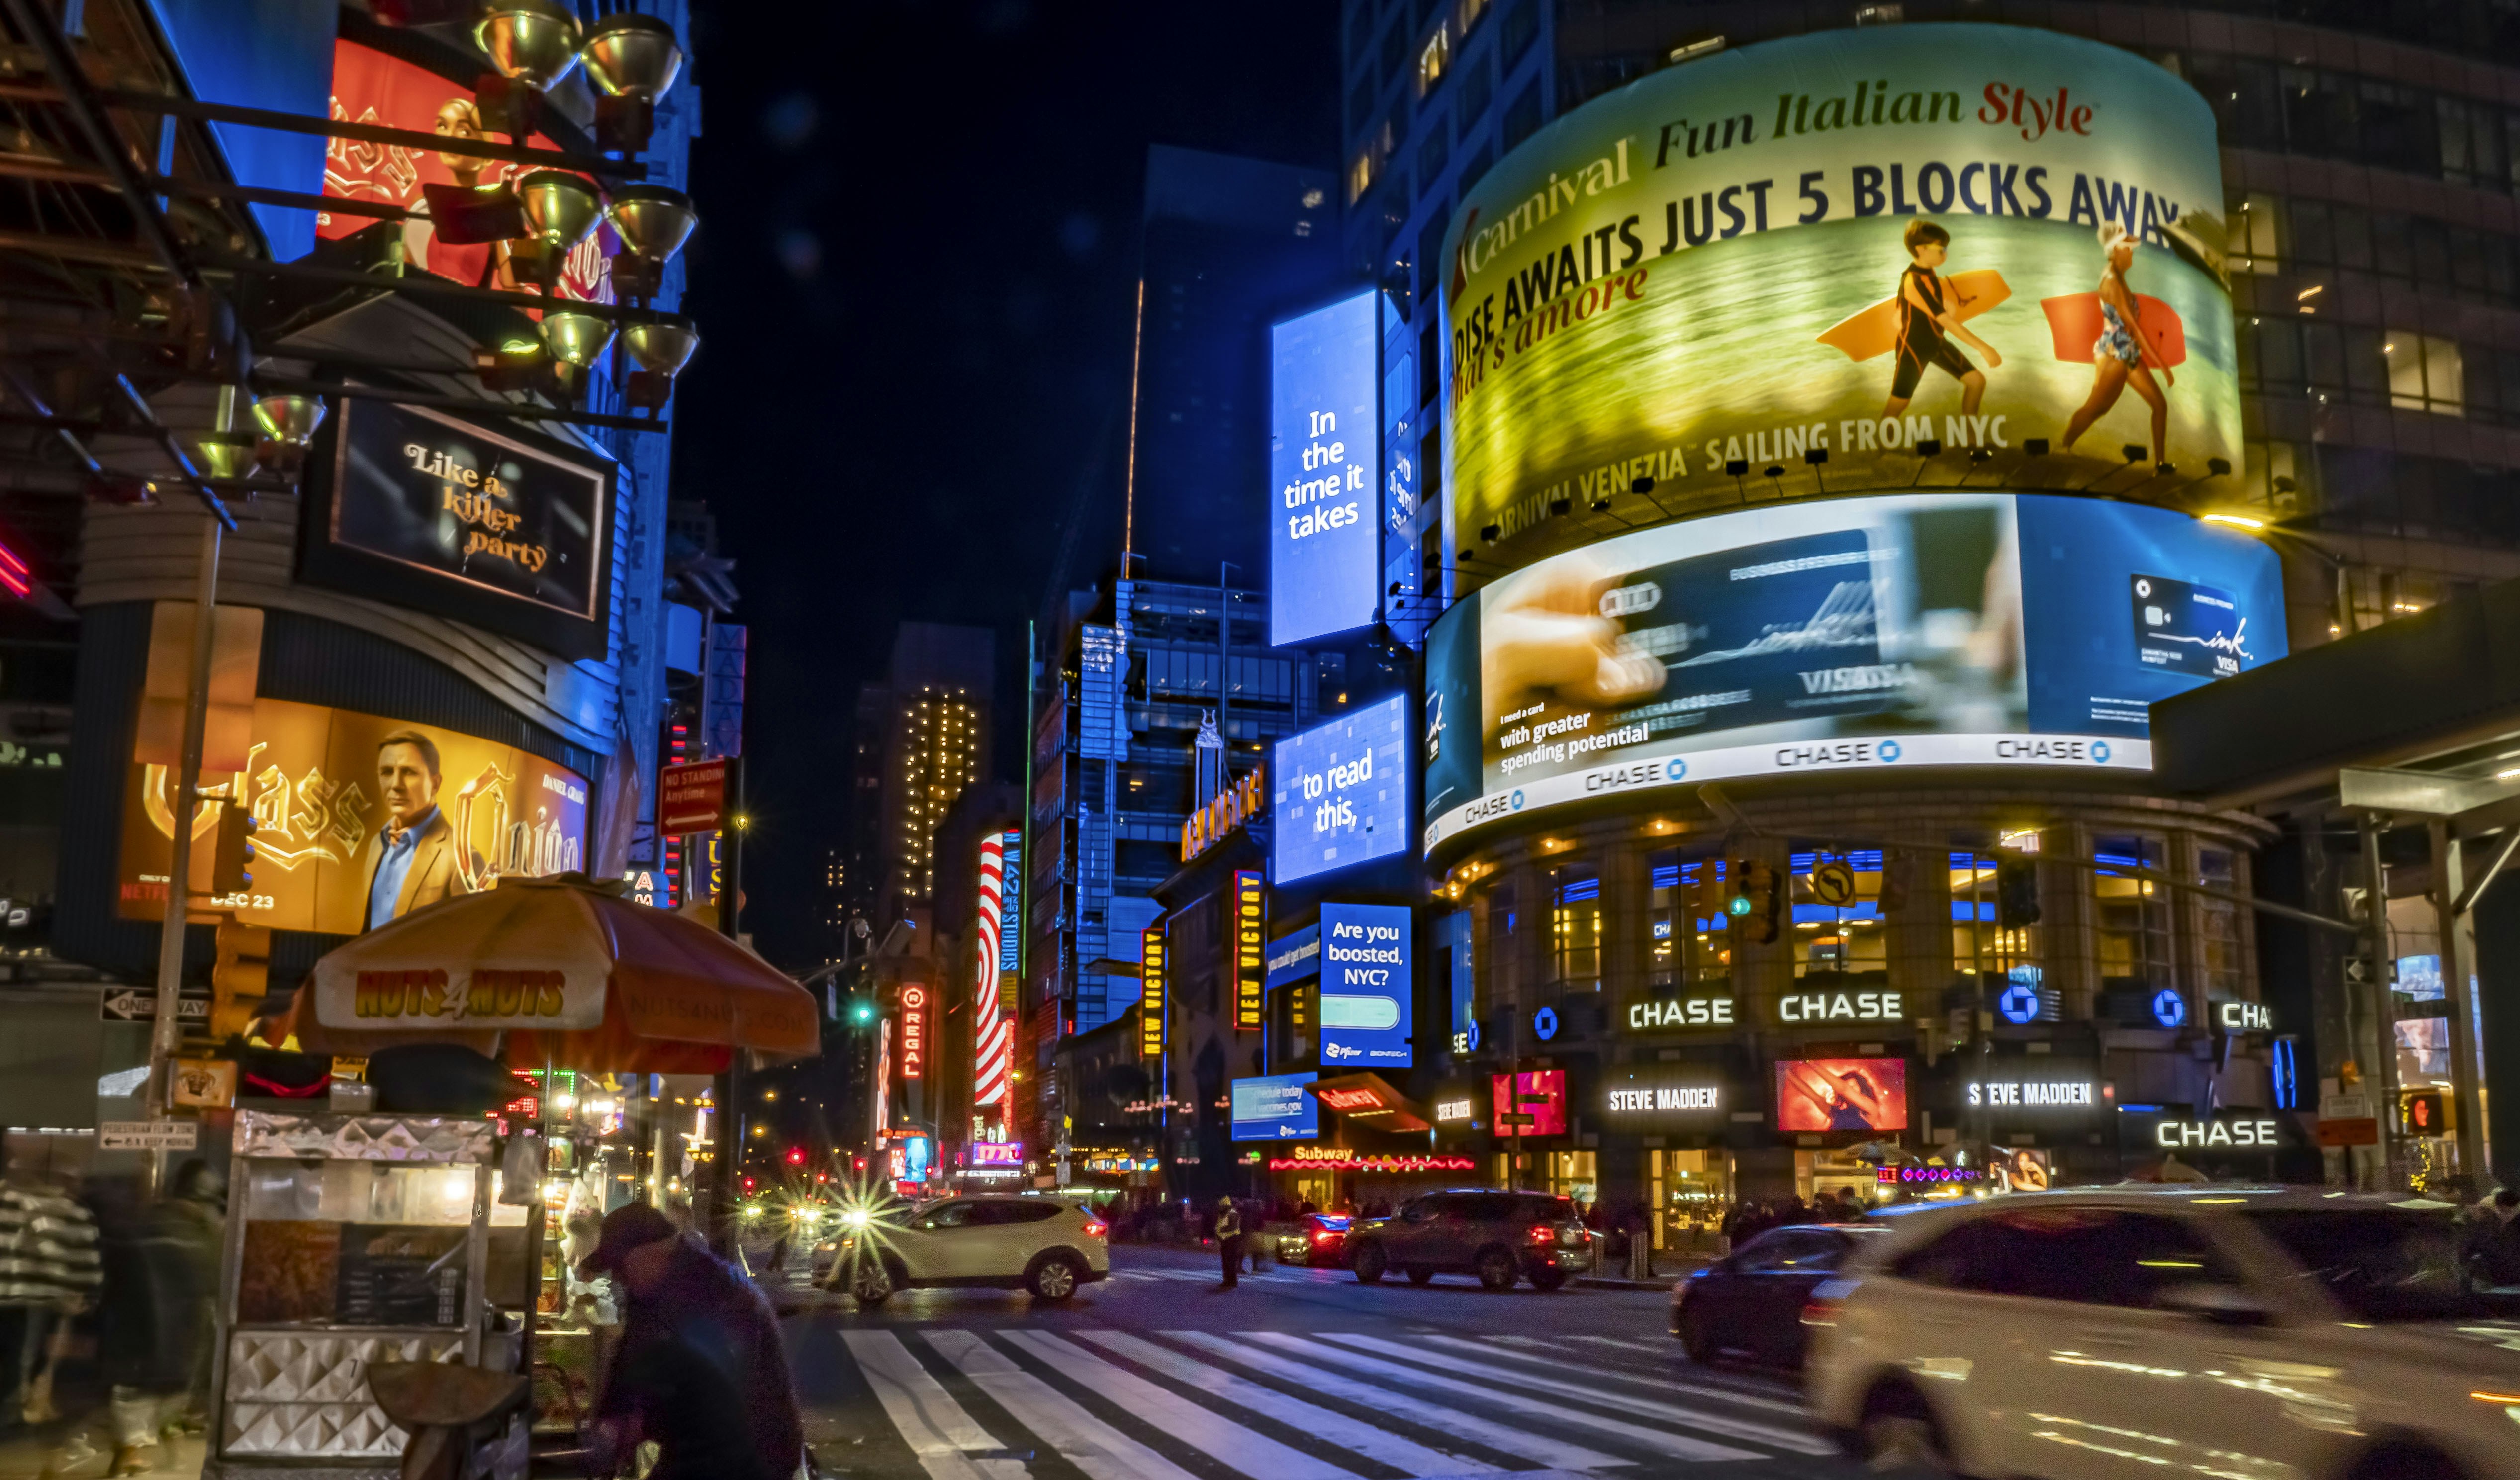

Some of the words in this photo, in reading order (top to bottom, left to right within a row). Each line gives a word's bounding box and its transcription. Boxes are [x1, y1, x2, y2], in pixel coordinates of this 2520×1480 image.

[1470, 138, 1632, 275] Carnival
[1656, 113, 1758, 169] Fun
[1773, 80, 1965, 138] Italian
[1977, 81, 2093, 141] Style
[1502, 214, 1643, 335] AWAITS
[1660, 178, 1774, 256] JUST
[1798, 170, 1829, 224] 5
[1852, 161, 2053, 219] BLOCKS
[2069, 172, 2179, 249] AWAY
[1514, 267, 1648, 355] amore
[1309, 411, 1336, 439] In
[403, 441, 479, 488] Like
[483, 475, 508, 498] a
[1301, 440, 1346, 473] the
[1284, 475, 1342, 510] time
[1346, 464, 1365, 492] it
[1493, 480, 1571, 542] ARNIVAL
[1578, 446, 1687, 504] VENEZIA
[1705, 422, 1828, 471] SAILING
[1840, 415, 1933, 453] FROM
[1945, 414, 2008, 449] NYC
[442, 483, 522, 532] killer
[1288, 501, 1359, 540] takes
[464, 530, 548, 573] party
[1500, 715, 1504, 724] I
[1527, 702, 1545, 714] card
[1500, 725, 1530, 749] with
[1532, 711, 1591, 744] greater
[1500, 743, 1565, 776] spending
[1568, 722, 1649, 761] potential
[1775, 743, 1872, 767] CHASE
[1996, 740, 2085, 761] CHASE
[665, 774, 679, 786] NO
[681, 768, 725, 784] STANDIN
[1303, 773, 1323, 800] to
[1327, 747, 1373, 792] read
[1586, 763, 1661, 791] CHASE
[665, 787, 705, 804] Anytime
[1465, 795, 1508, 824] CHASE
[1315, 796, 1357, 832] this,
[252, 895, 274, 909] 23
[1240, 876, 1260, 968] VICTORY
[1332, 921, 1363, 940] Are
[1366, 925, 1399, 944] you
[1000, 913, 1019, 971] STUDIOS
[1328, 943, 1403, 966] boosted,
[1145, 932, 1162, 1009] VICTORY
[1344, 969, 1389, 987] NYC?
[118, 998, 150, 1012] ONE
[1240, 979, 1260, 1024] NEW
[1630, 999, 1734, 1028] CHASE
[1780, 993, 1903, 1021] CHASE
[905, 1013, 920, 1077] REGAL
[1144, 1017, 1161, 1055] NEW
[1282, 1085, 1303, 1100] today
[1609, 1089, 1654, 1110] STEVE
[1657, 1087, 1717, 1109] MADDEN
[1968, 1082, 2020, 1106] SEVE
[2023, 1082, 2092, 1104] MADDEN
[2157, 1120, 2278, 1147] CHASE
[1295, 1146, 1353, 1162] Subway
